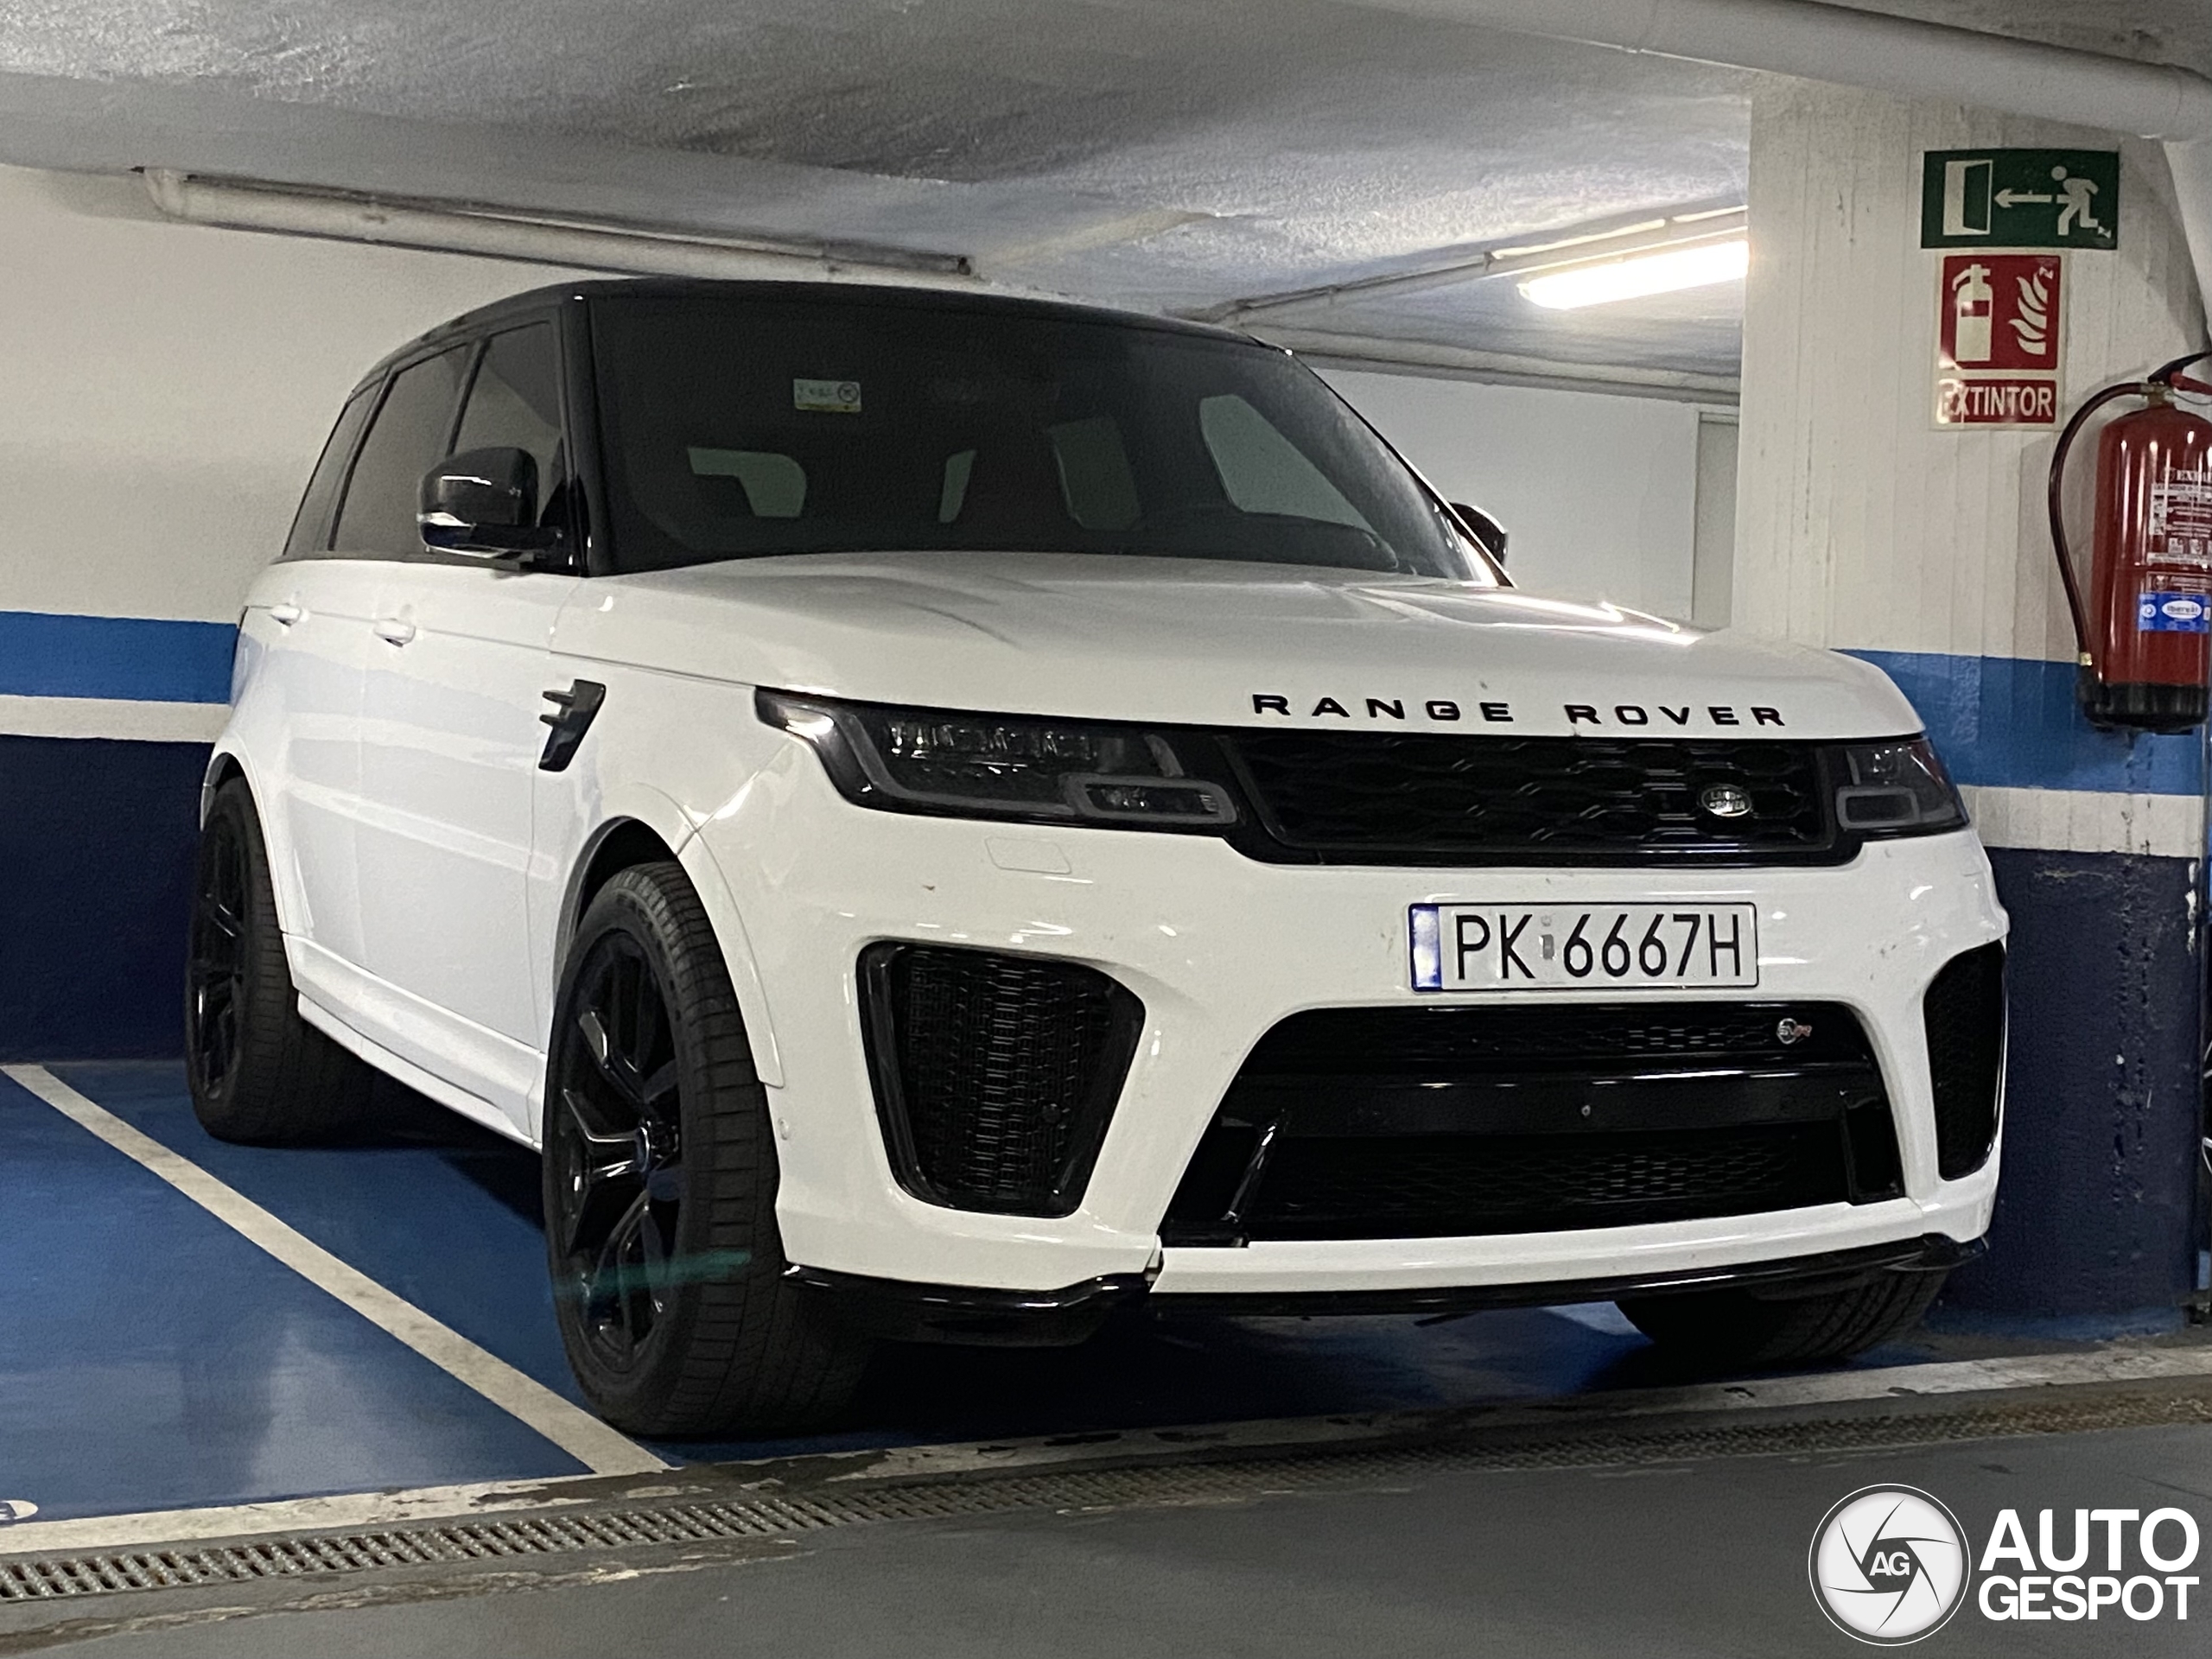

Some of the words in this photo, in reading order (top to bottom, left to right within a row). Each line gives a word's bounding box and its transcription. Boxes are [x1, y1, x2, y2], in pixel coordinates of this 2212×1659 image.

[1252, 693, 1515, 723] RANGE
[1564, 703, 1786, 728] ROVER
[1455, 913, 1536, 981] PK
[1562, 912, 1741, 978] 6667H
